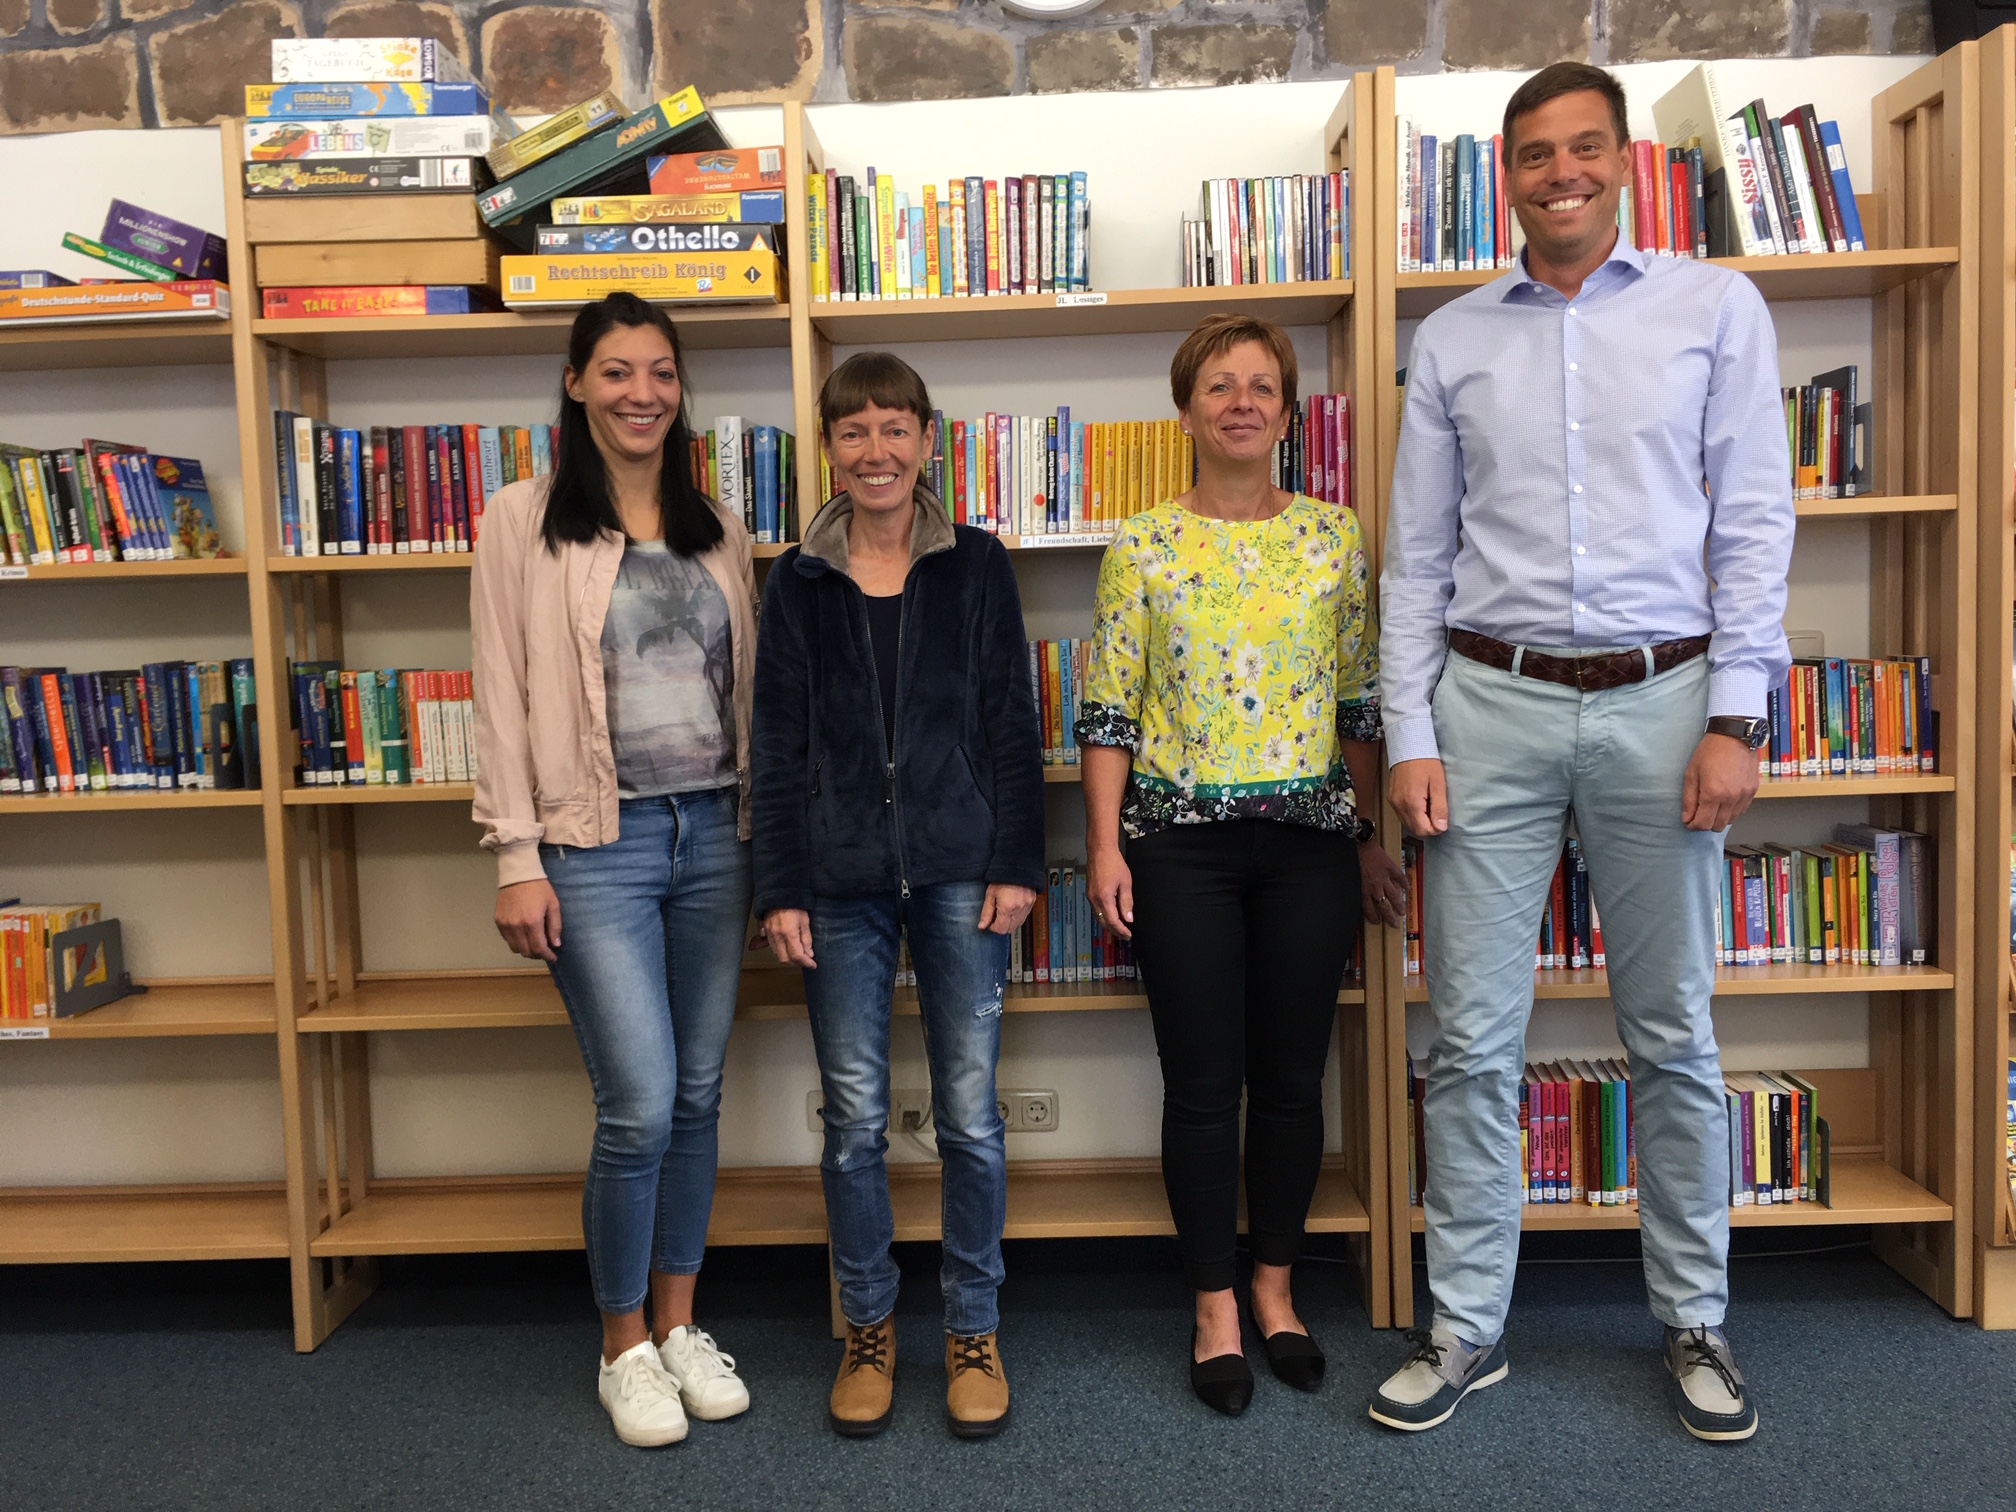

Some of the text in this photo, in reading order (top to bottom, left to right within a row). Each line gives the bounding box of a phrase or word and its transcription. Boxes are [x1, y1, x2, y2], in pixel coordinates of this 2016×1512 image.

[422, 39, 433, 79] KOSMOS
[310, 134, 363, 150] LEBENS
[1721, 131, 1731, 157] DANKE
[1756, 144, 1768, 172] Kennedy
[1737, 158, 1761, 205] Sissy
[1765, 179, 1773, 195] John
[633, 203, 726, 222] SAGALAND
[118, 217, 188, 247] MILLIONENSHOW
[631, 225, 740, 251] Othello
[809, 194, 817, 263] Witze-Parade
[925, 192, 938, 276] Die besten Schülerwitze
[986, 189, 997, 270] Die besten Kinderwitze
[547, 263, 727, 281] Rechtschreib König
[22, 292, 165, 308] Deutschstunde-Standard-Quiz
[303, 300, 337, 312] TAKE
[1073, 295, 1104, 304] Lustiges
[482, 439, 495, 493] Lionheart
[720, 432, 735, 501] VORTEX
[468, 452, 480, 512] DIE TODESBUCHT
[1038, 535, 1090, 546] Freundschaft,
[1091, 534, 1112, 543] Liebe
[1753, 878, 1763, 927] BLAUEN KAPUZEN
